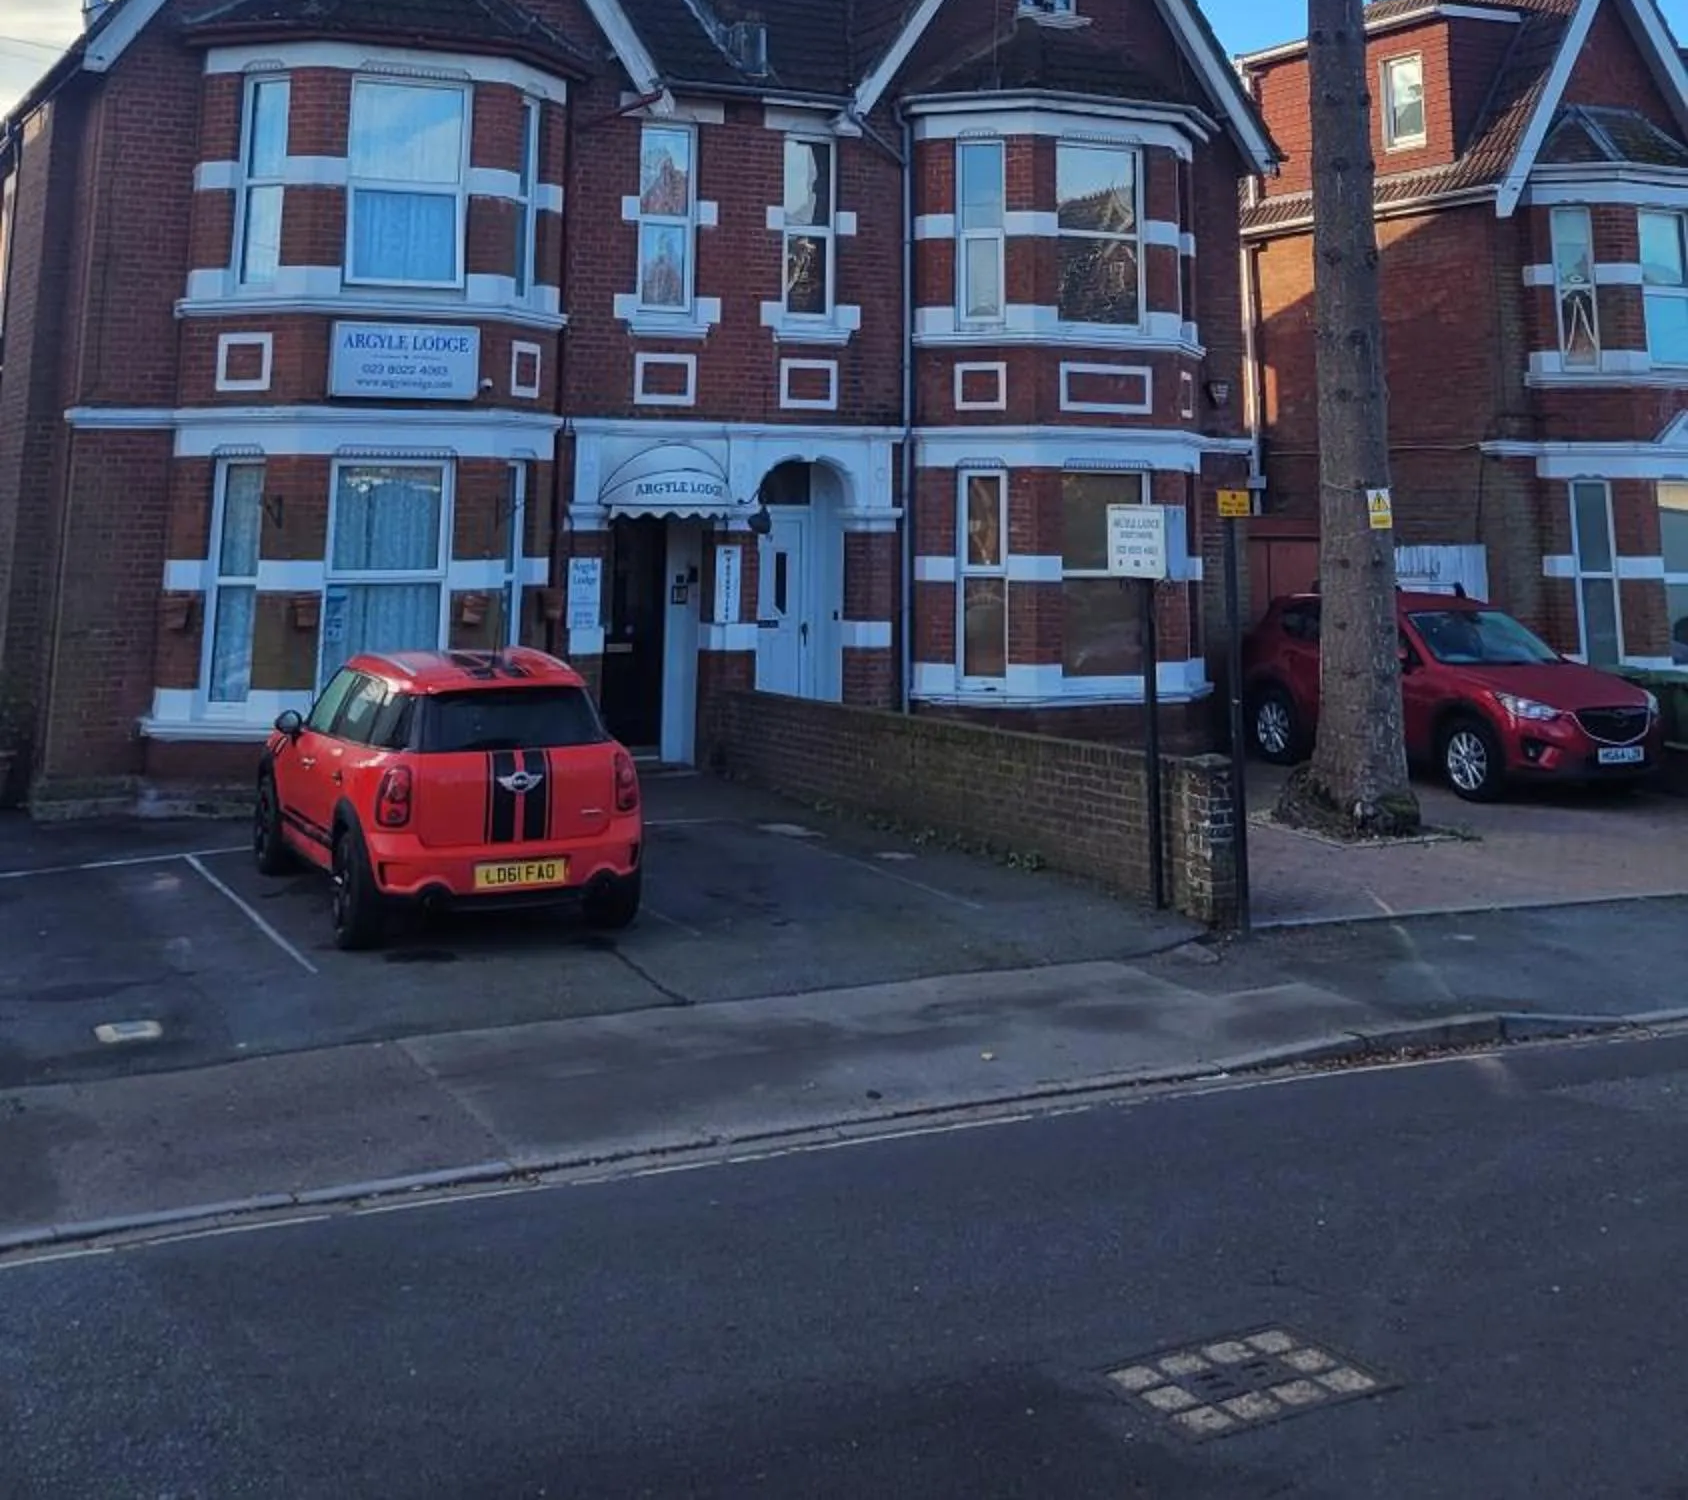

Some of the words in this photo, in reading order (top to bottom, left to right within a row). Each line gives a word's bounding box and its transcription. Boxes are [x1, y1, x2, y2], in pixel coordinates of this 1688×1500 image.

[343, 331, 408, 350] ARGYLE
[412, 333, 470, 353] LODGE
[361, 363, 384, 374] 023
[634, 481, 687, 496] ARGYLE
[690, 482, 724, 496] LODGE
[485, 867, 521, 885] LD61
[524, 863, 556, 882] FAO
